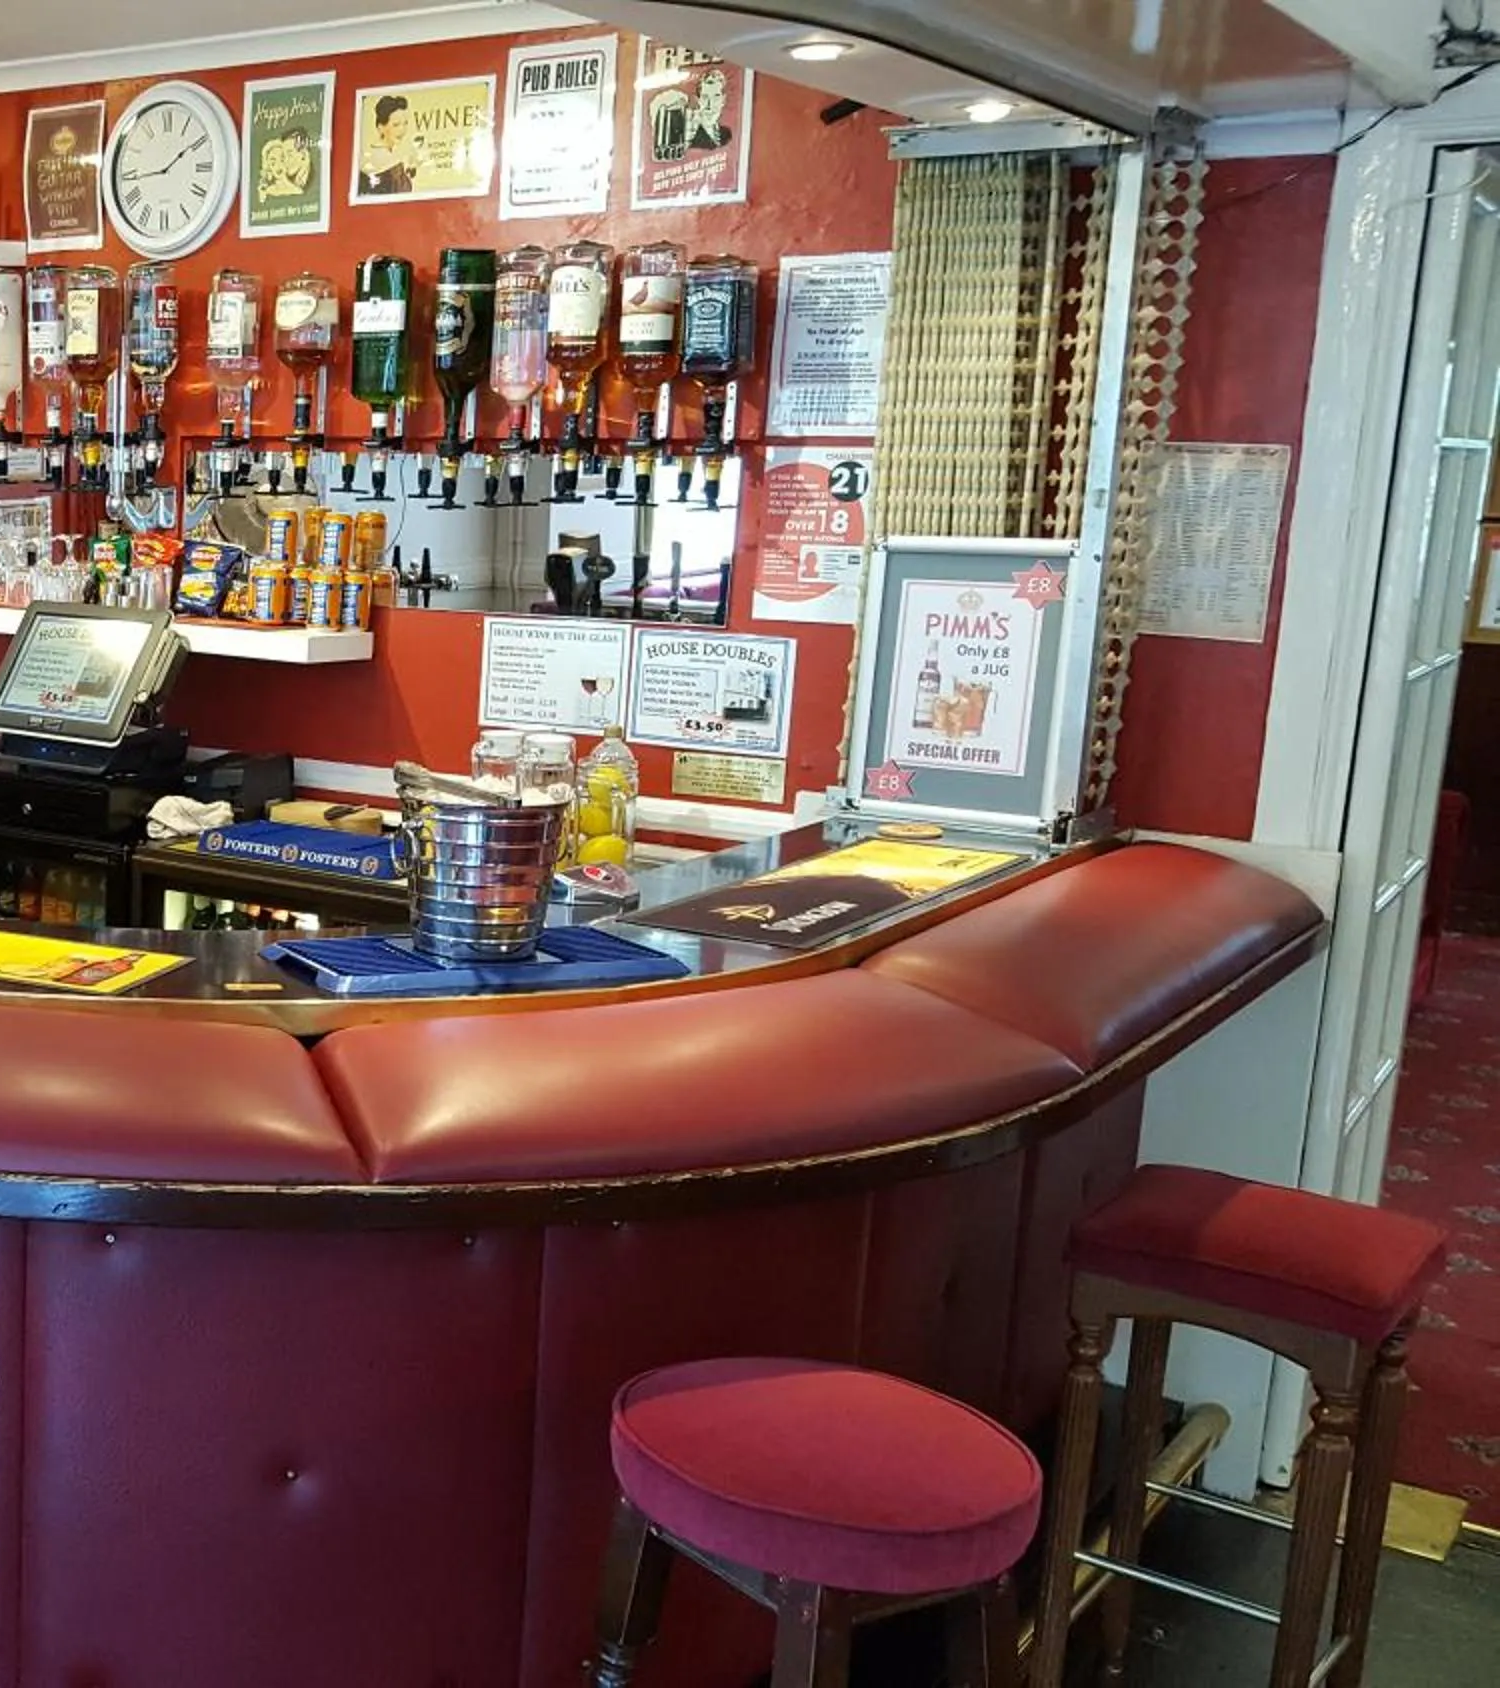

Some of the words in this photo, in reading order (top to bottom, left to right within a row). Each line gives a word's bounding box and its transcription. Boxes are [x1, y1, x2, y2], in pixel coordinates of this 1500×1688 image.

[521, 66, 550, 93] PUB
[555, 58, 599, 89] RULES
[830, 466, 867, 495] 21
[785, 519, 816, 531] OVER
[819, 510, 849, 535] 18
[1027, 577, 1051, 593] £8
[925, 611, 1010, 641] PIMM'S
[646, 641, 699, 659] HOUSE
[703, 643, 777, 669] DOUBLES
[957, 643, 989, 660] Only
[992, 646, 1010, 659] £8
[981, 661, 1009, 677] JUG
[684, 718, 724, 733] £3.50
[907, 741, 959, 762] SPECIAL
[962, 746, 1001, 765] OFFER
[877, 773, 901, 790] £8
[223, 837, 282, 858] FOSTER'S
[299, 849, 359, 869] FOSTER'S
